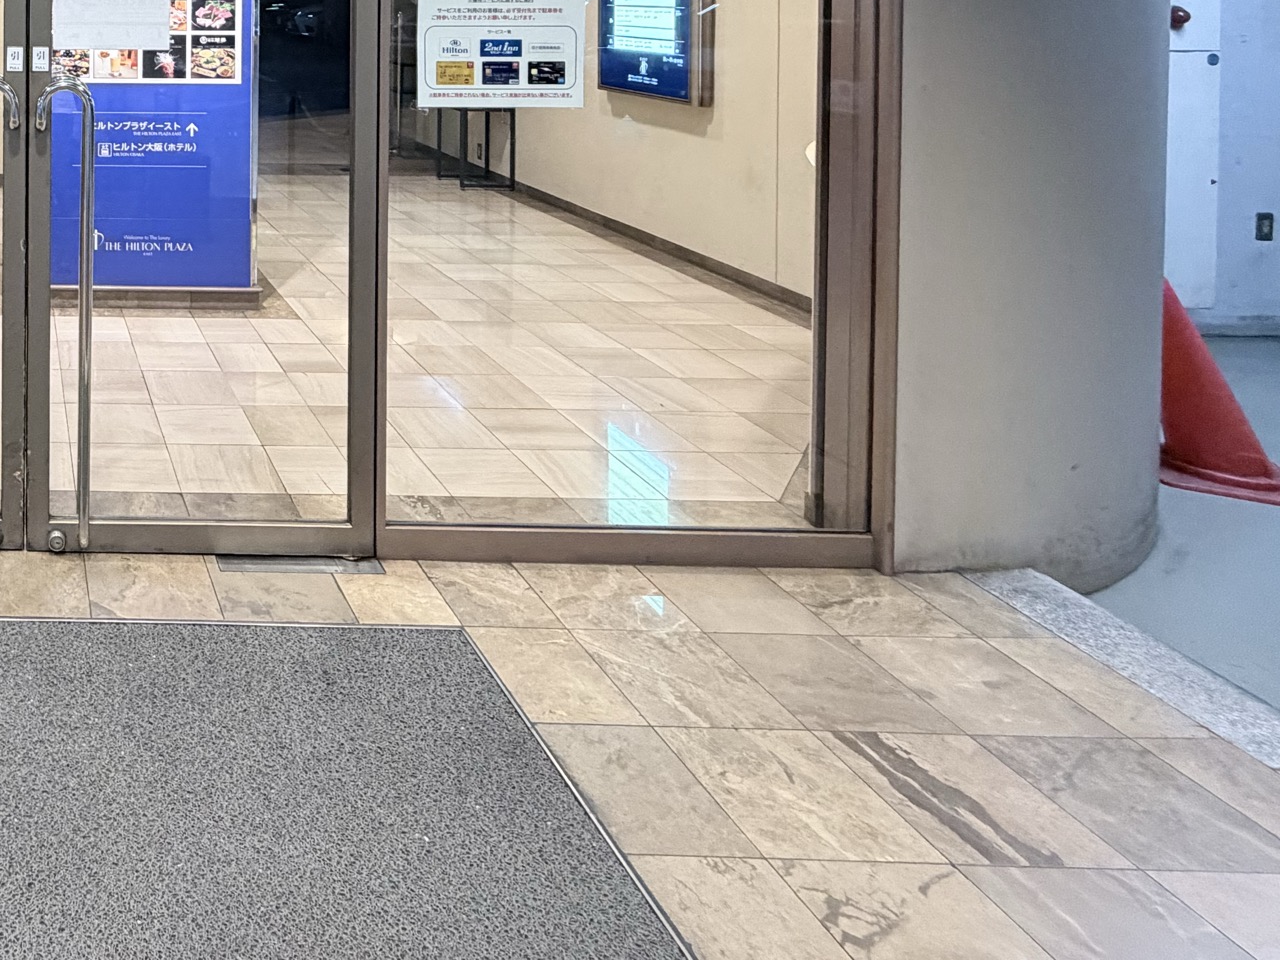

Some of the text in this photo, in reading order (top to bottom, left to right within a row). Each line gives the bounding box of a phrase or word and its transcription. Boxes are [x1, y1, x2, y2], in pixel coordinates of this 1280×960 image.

[441, 46, 469, 54] Hilton
[483, 41, 502, 52] 2nd
[10, 50, 20, 61] 引
[36, 50, 45, 61] 引
[104, 241, 194, 252] THE HILTON PLAZA
